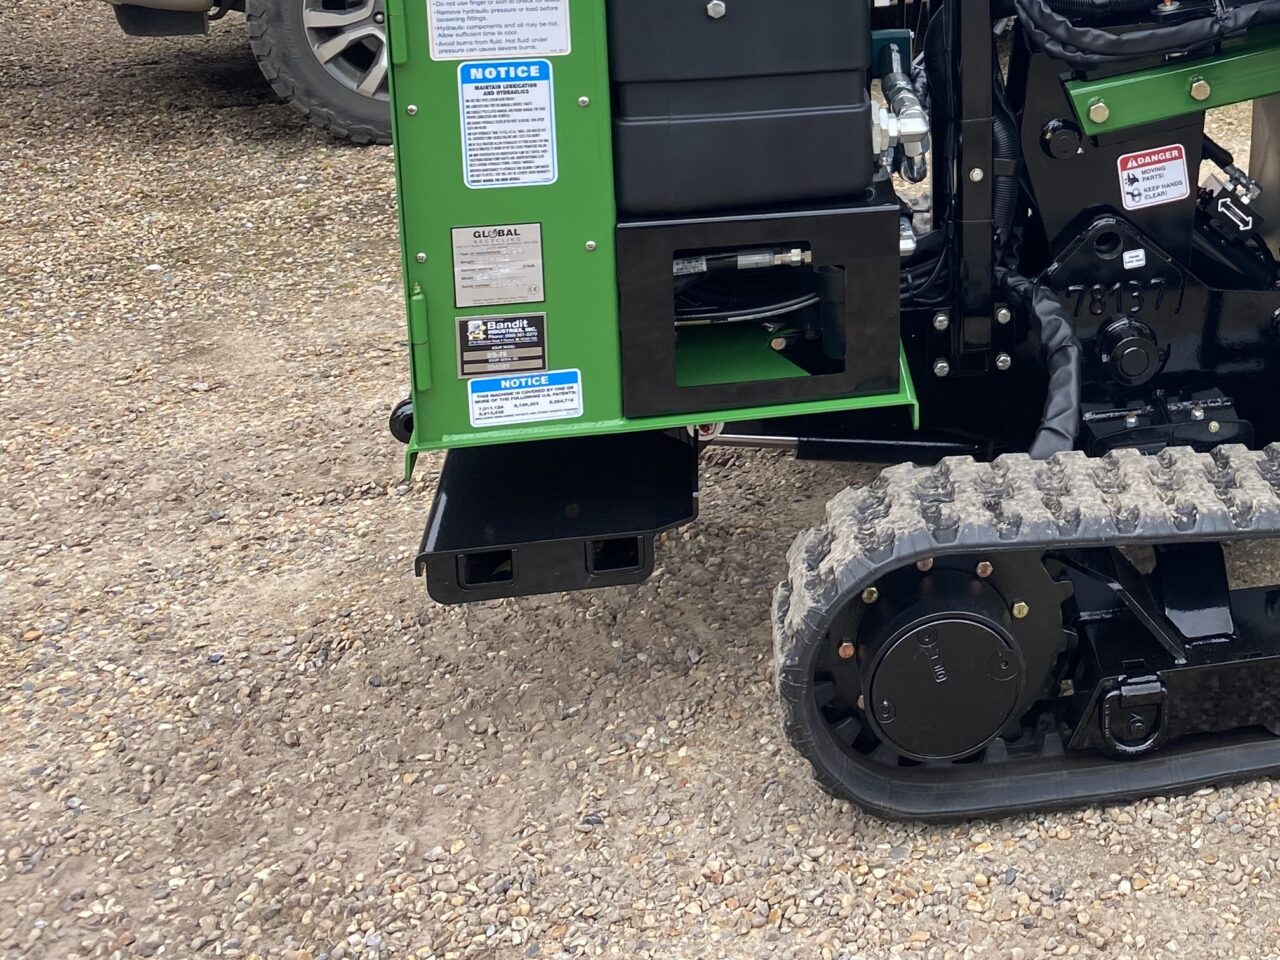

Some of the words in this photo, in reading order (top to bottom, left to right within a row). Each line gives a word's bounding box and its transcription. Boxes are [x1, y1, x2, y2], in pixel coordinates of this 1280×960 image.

[470, 65, 539, 80] NOTICE
[1137, 150, 1179, 164] DANGER
[1141, 166, 1166, 175] MOVING
[1142, 173, 1165, 182] PARTS!
[1143, 185, 1160, 193] KEEP
[1161, 180, 1183, 189] HANDS
[1144, 191, 1168, 200] CLEAR!
[473, 228, 520, 239] GLOBAL
[487, 318, 528, 330] Bandit
[500, 375, 549, 388] NOTICE
